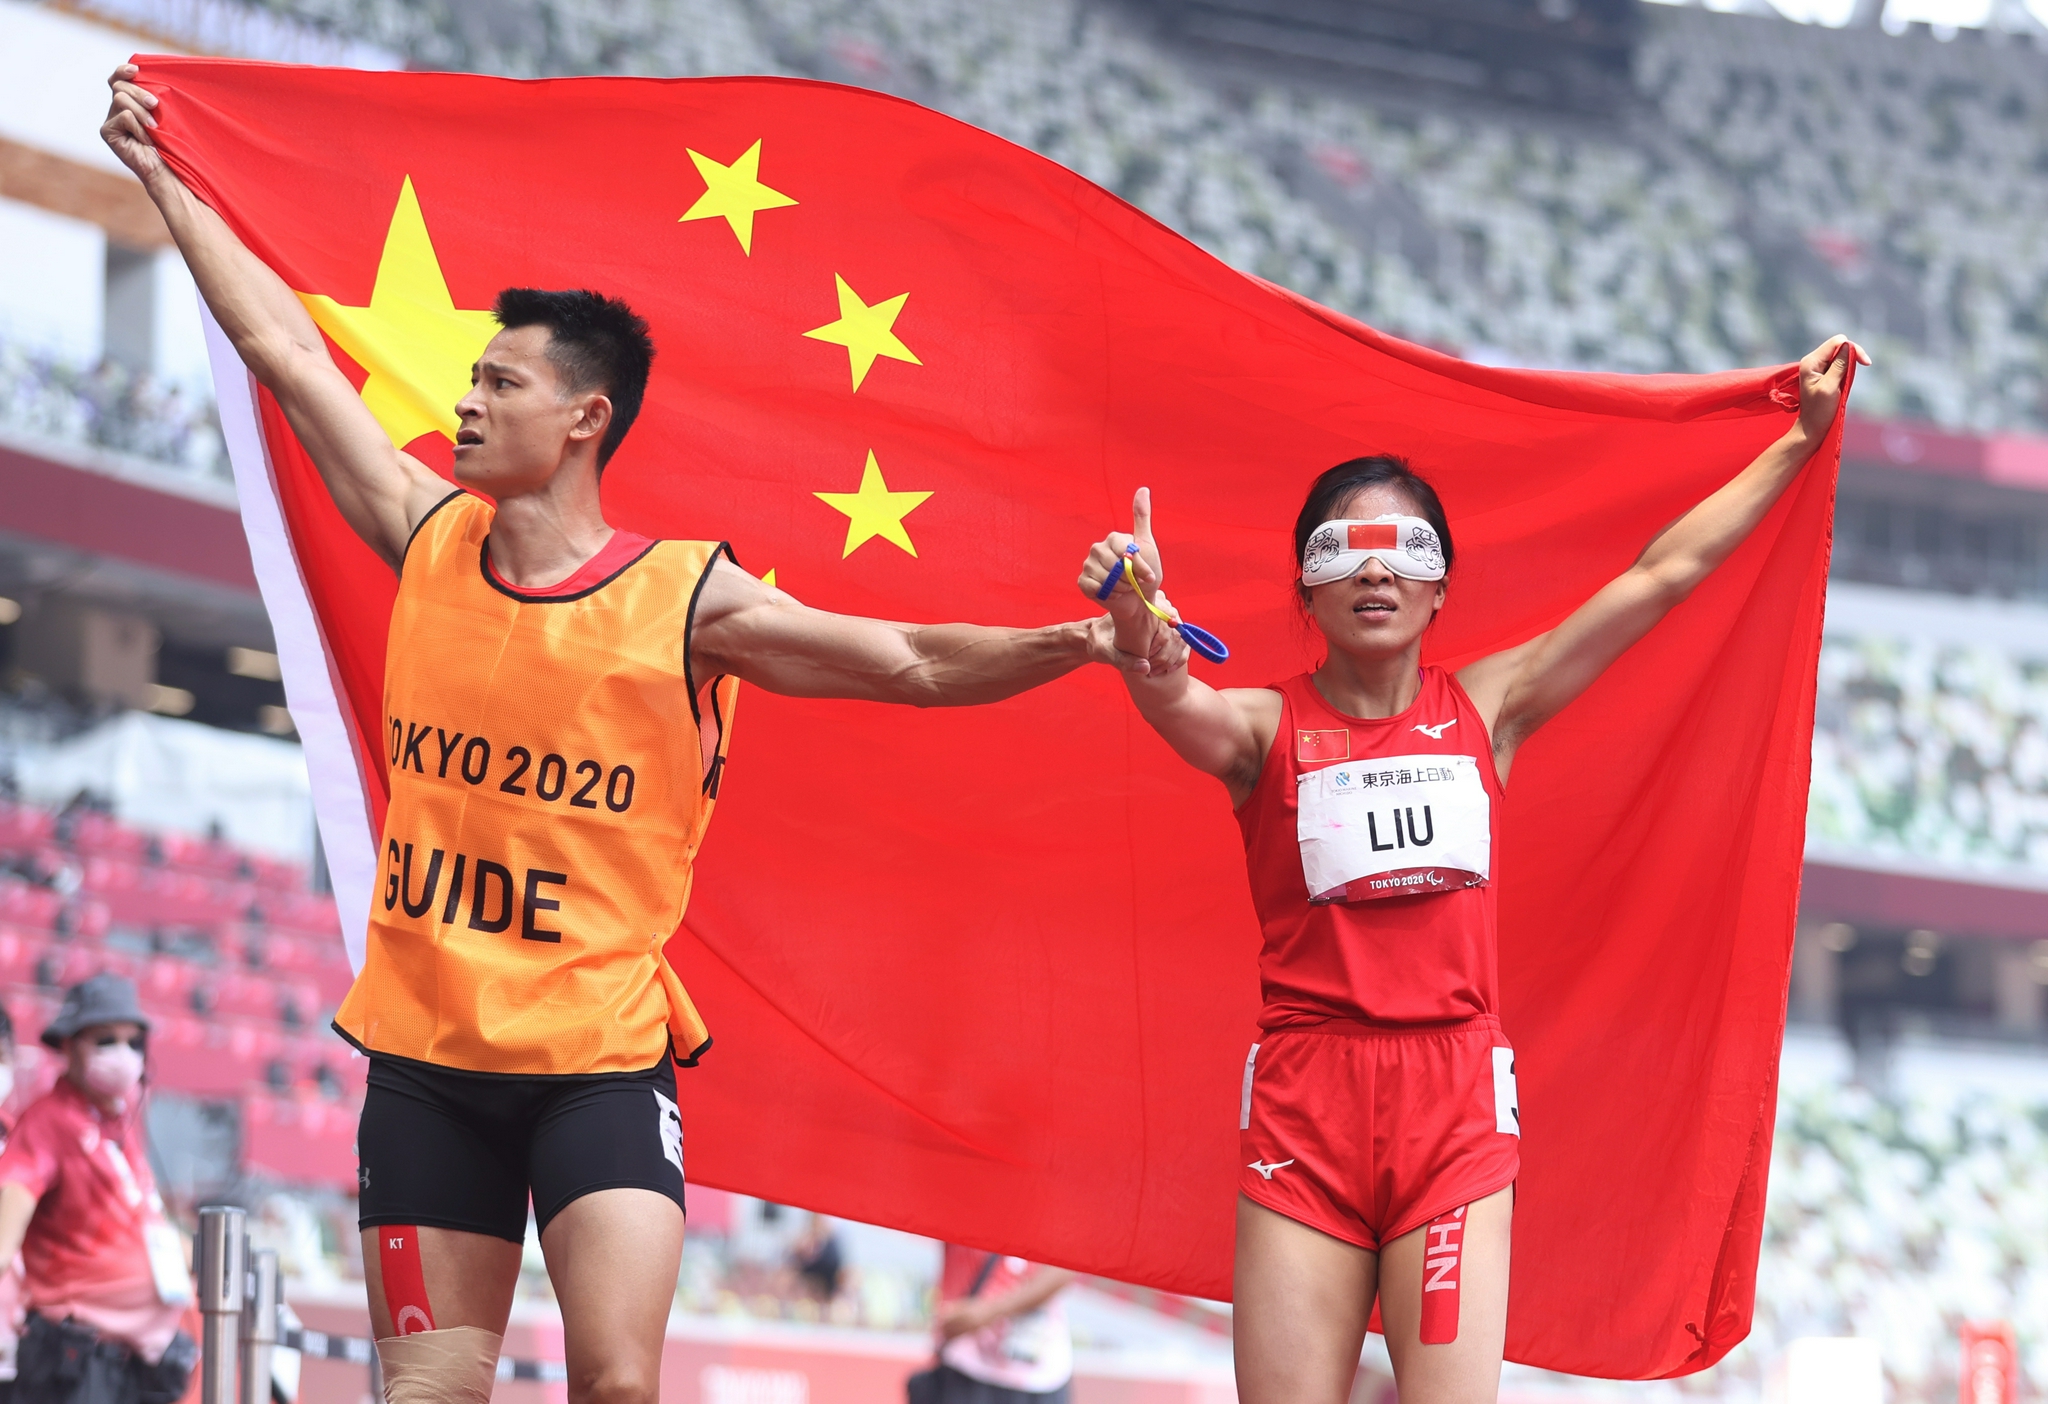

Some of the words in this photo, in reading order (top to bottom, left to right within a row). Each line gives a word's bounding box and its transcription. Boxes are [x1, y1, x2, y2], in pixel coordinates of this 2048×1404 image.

[389, 715, 490, 785] OKYO
[500, 746, 635, 813] 2020
[1362, 767, 1455, 789] 東京海上日動
[1367, 805, 1434, 852] LIU
[385, 838, 567, 943] GUIDE
[1370, 878, 1400, 890] TOKYO
[1401, 875, 1424, 886] 2020
[389, 1238, 404, 1249] KT
